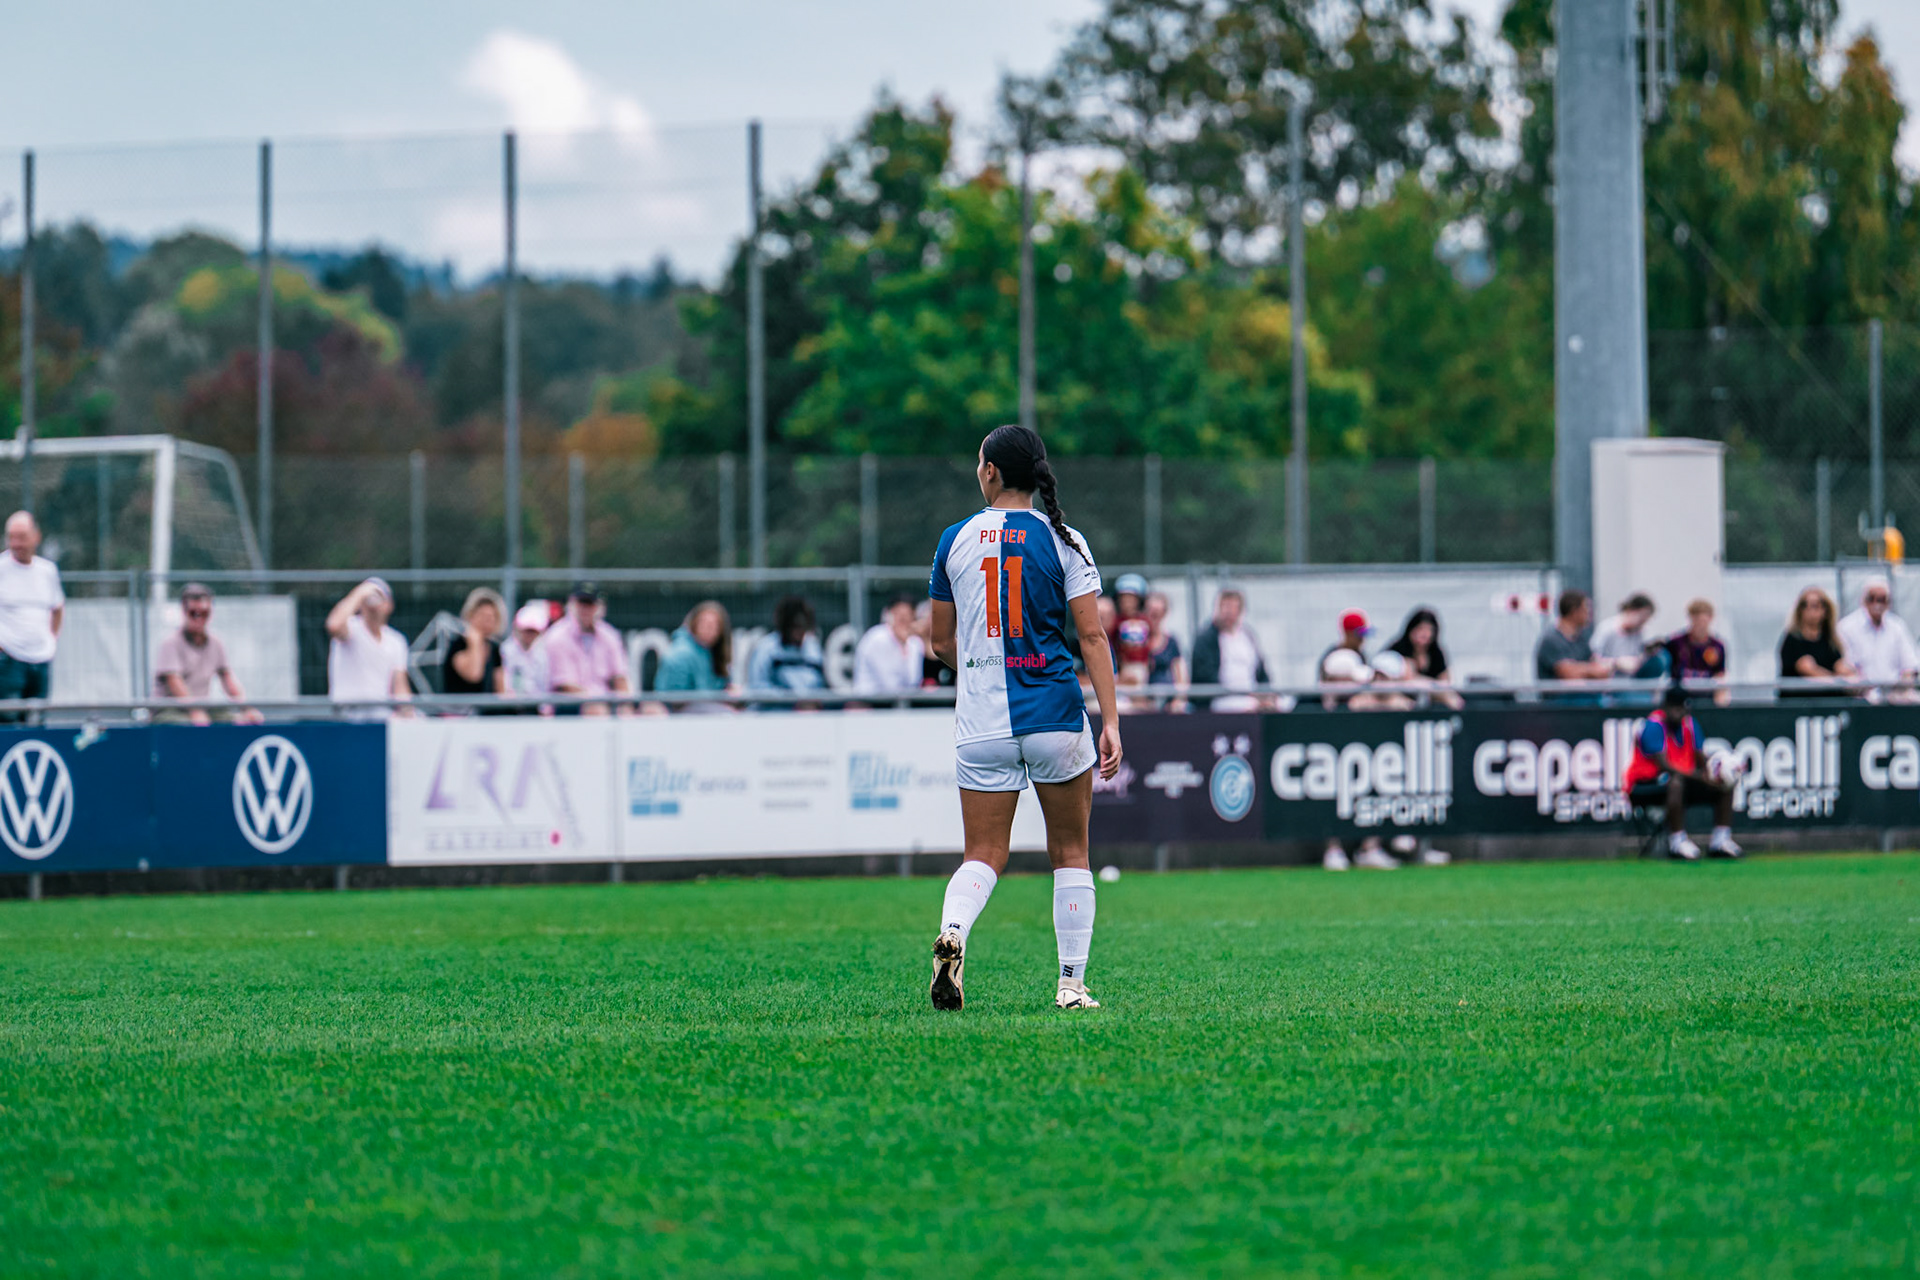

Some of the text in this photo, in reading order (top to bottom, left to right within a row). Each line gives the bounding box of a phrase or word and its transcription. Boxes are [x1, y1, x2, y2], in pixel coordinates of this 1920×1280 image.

[980, 529, 1027, 544] POTIER
[979, 556, 1024, 638] 11
[975, 657, 1003, 669] Spross
[1271, 719, 1454, 820] capelli
[1473, 717, 1647, 815] capell
[1354, 795, 1451, 827] SPORT
[1747, 788, 1838, 819] SPORT
